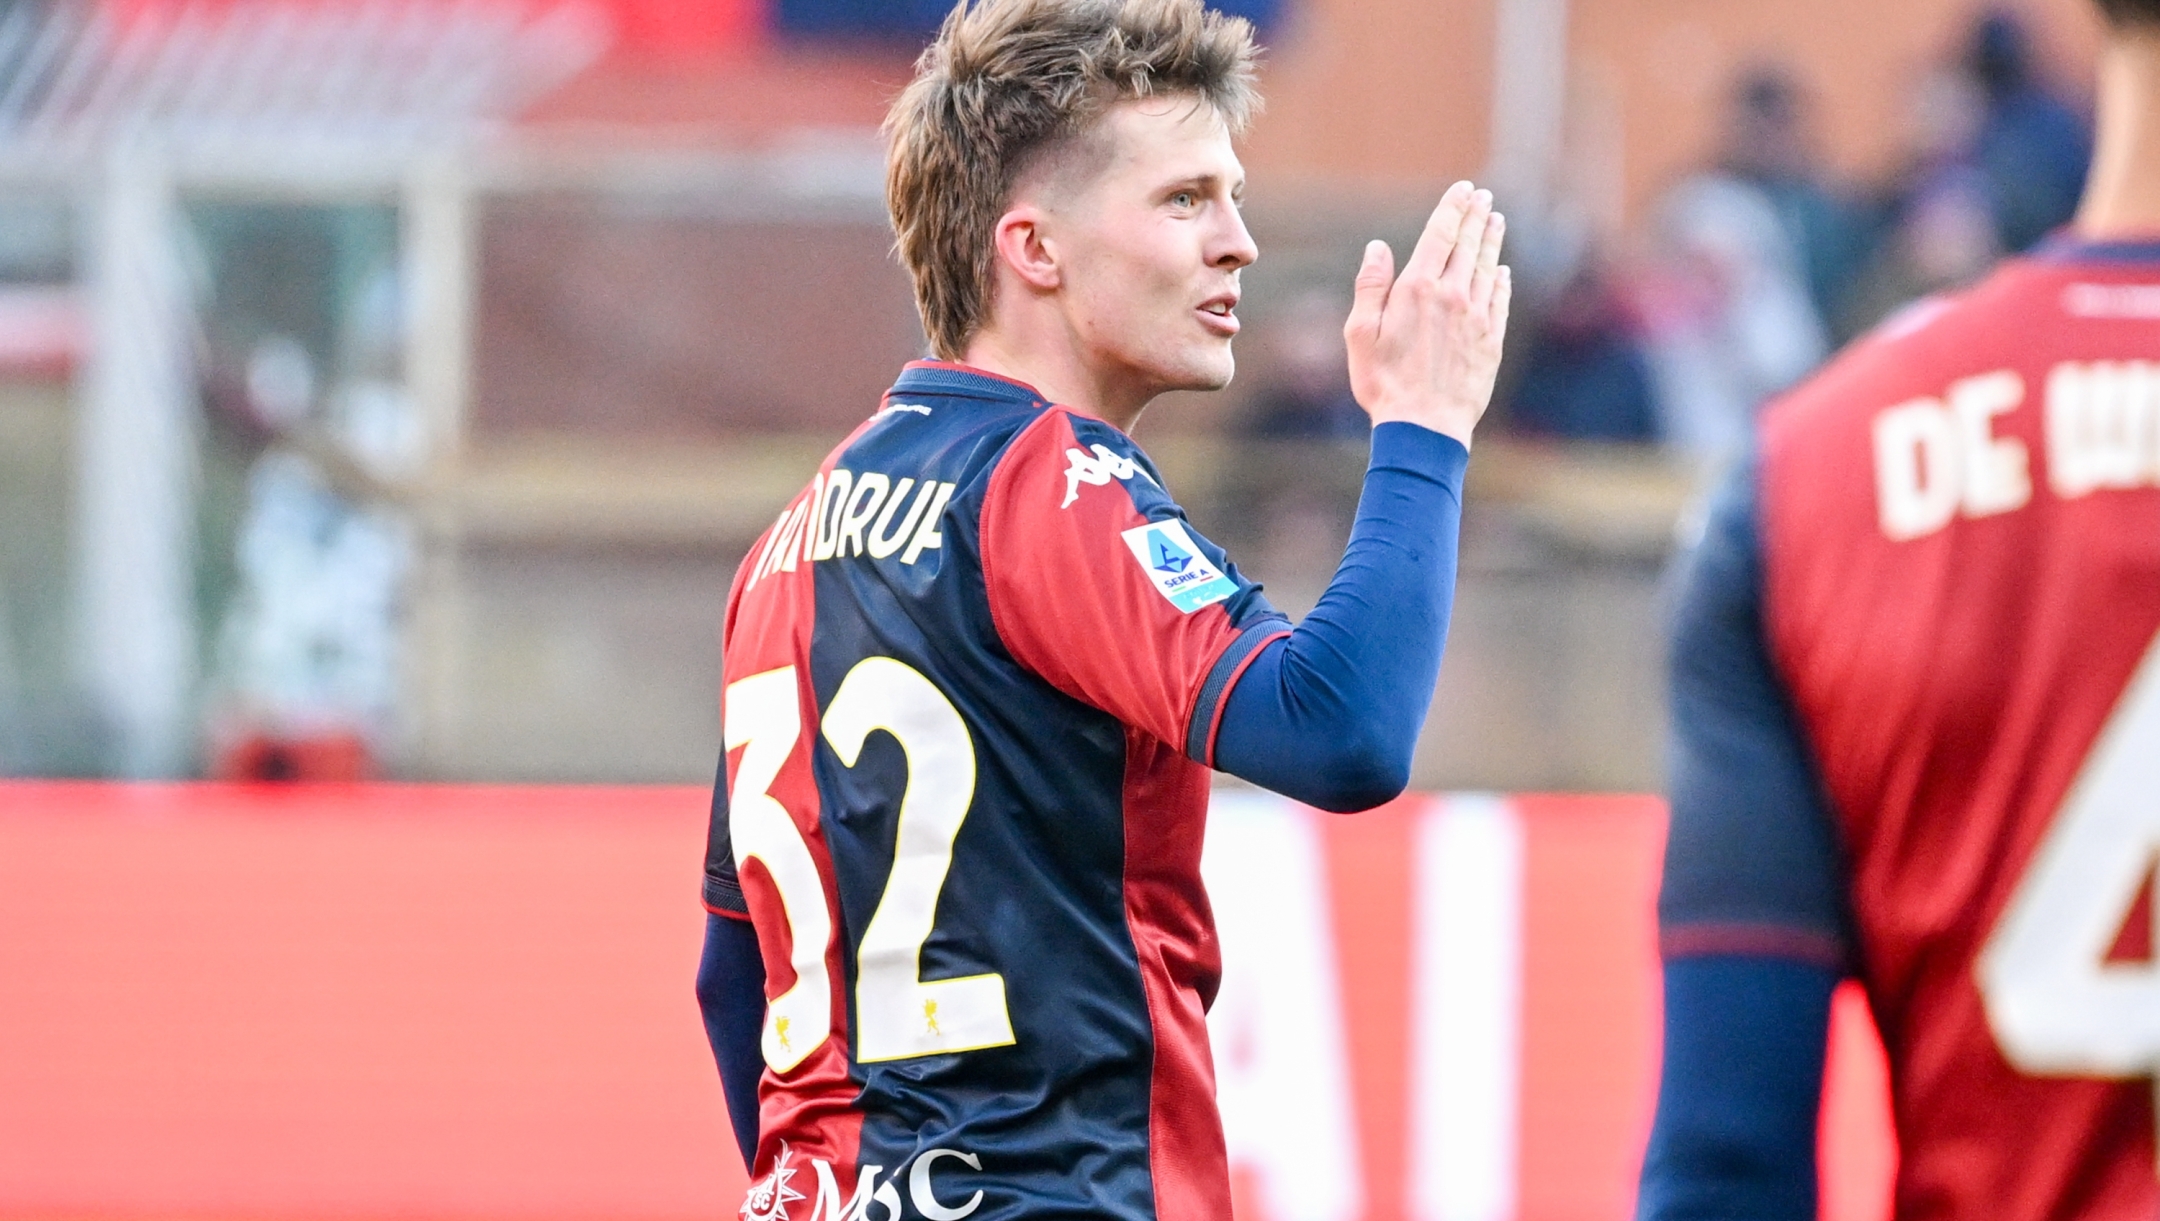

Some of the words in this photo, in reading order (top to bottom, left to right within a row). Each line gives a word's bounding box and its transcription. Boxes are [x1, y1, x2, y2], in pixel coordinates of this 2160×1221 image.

[1165, 571, 1198, 588] SERIE
[1873, 369, 2032, 541] DE
[2043, 358, 2160, 501] W
[724, 655, 1017, 1075] 32
[1971, 620, 2160, 1180] 4
